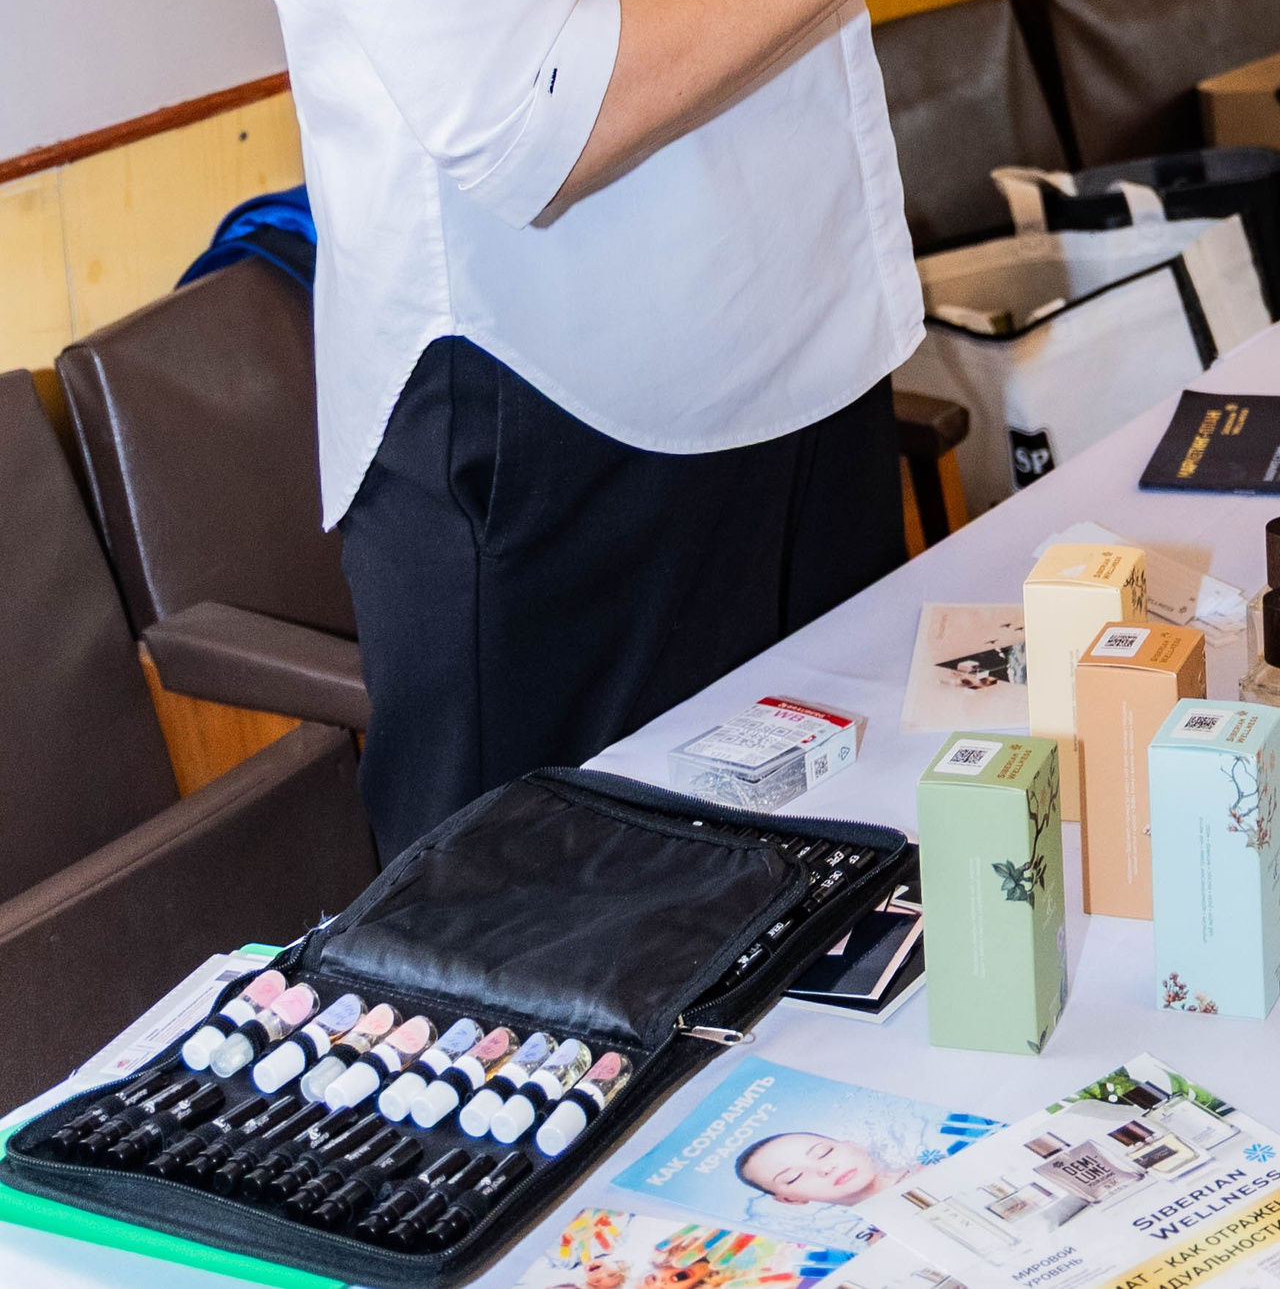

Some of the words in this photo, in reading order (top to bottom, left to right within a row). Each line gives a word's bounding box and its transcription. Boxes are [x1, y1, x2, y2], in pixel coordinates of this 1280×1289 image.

[1015, 446, 1049, 475] SP
[1226, 718, 1246, 743] SIBERIAN
[1236, 716, 1258, 744] WELLNESS
[646, 1156, 690, 1188] КАК
[682, 1076, 776, 1159] СОХРАНИТЬ
[694, 1102, 778, 1175] КРАСОТУ?
[1062, 1154, 1098, 1177] DEMI-
[1075, 1163, 1111, 1185] LUNE
[1132, 1168, 1247, 1231] SIBERIAN
[1012, 1245, 1077, 1282] МИРОВОЙ
[1164, 1243, 1204, 1268] КАК
[1023, 1258, 1084, 1289] УРОВЕНЬ
